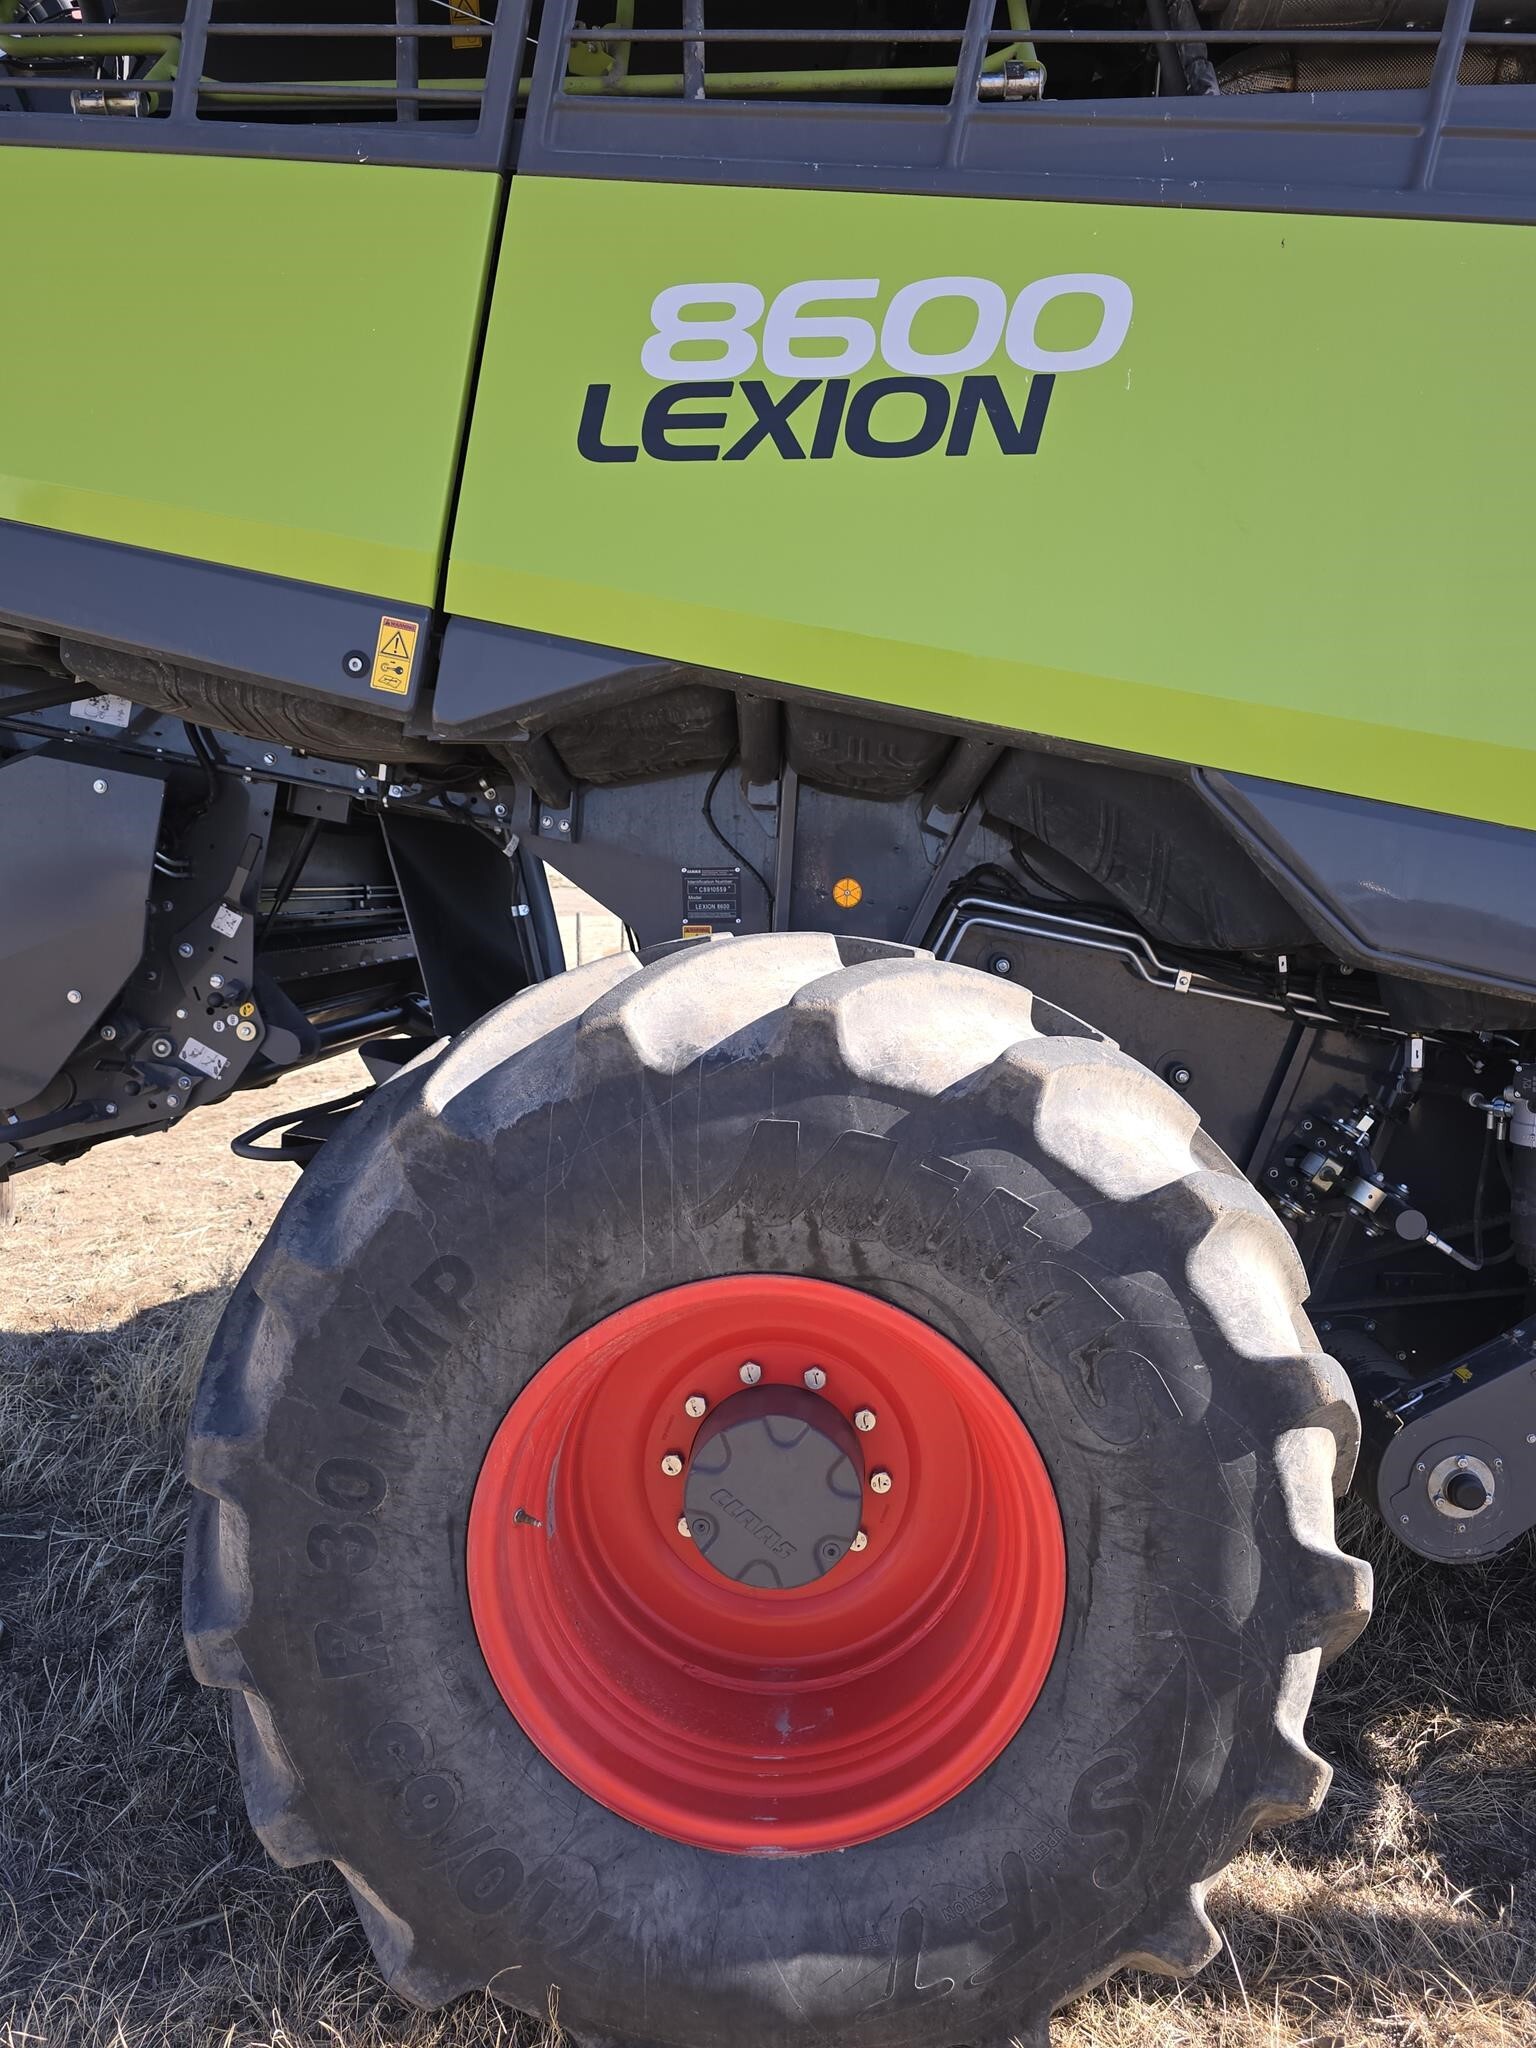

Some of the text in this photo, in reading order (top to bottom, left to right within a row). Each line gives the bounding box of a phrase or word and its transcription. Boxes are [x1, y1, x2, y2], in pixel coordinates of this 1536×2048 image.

[641, 273, 1134, 381] 8600
[576, 373, 1056, 463] LEXION
[338, 1253, 477, 1432] IMP
[710, 1488, 798, 1560] CLAAS
[312, 1611, 391, 1679] R
